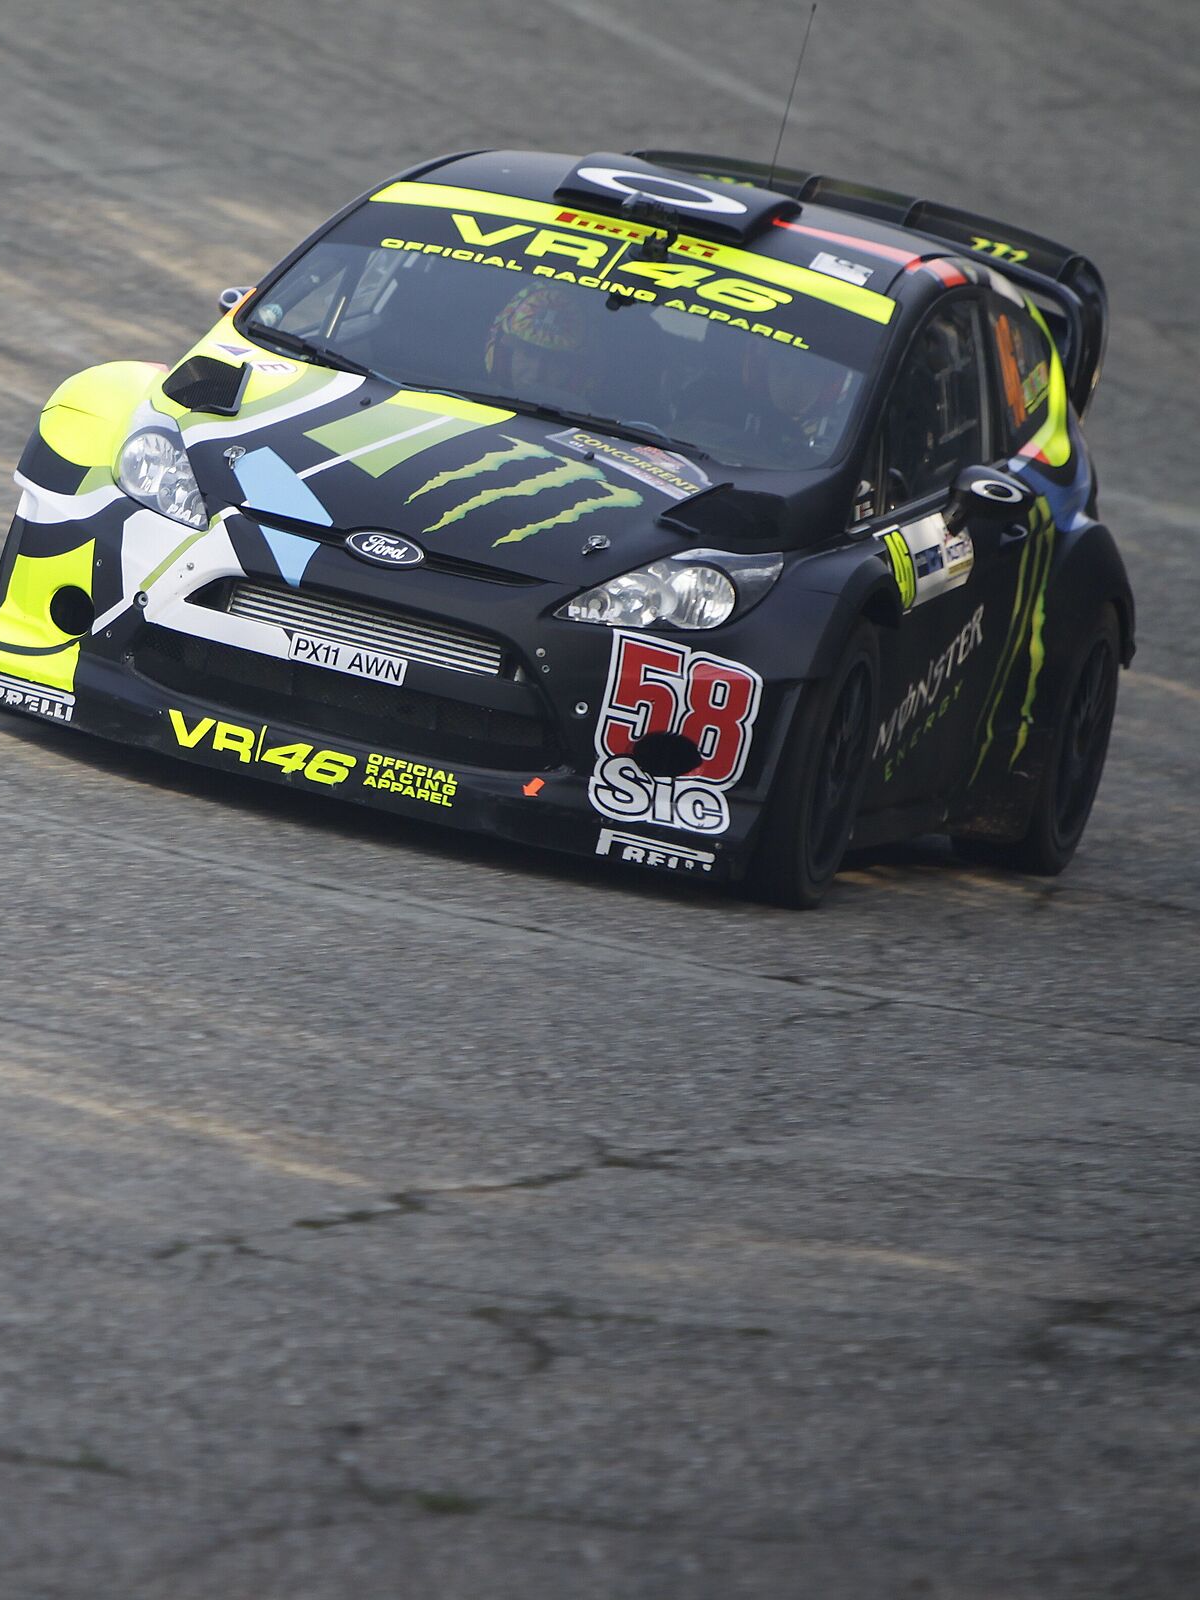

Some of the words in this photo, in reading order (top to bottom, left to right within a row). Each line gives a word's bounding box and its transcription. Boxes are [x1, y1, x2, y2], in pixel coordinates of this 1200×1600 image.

[380, 237, 523, 271] OFFICIAL
[532, 265, 658, 302] RACING
[664, 299, 809, 350] APPAREL
[573, 433, 701, 494] CONCORRENT
[166, 503, 202, 526] PIAA
[361, 534, 408, 561] Ford
[293, 638, 341, 666] PX11
[347, 652, 403, 681] AWN
[597, 631, 760, 788] 58
[364, 764, 457, 796] RACING
[367, 753, 458, 785] OFFICIAL
[362, 775, 453, 807] APPAREL
[591, 755, 726, 831] Sic
